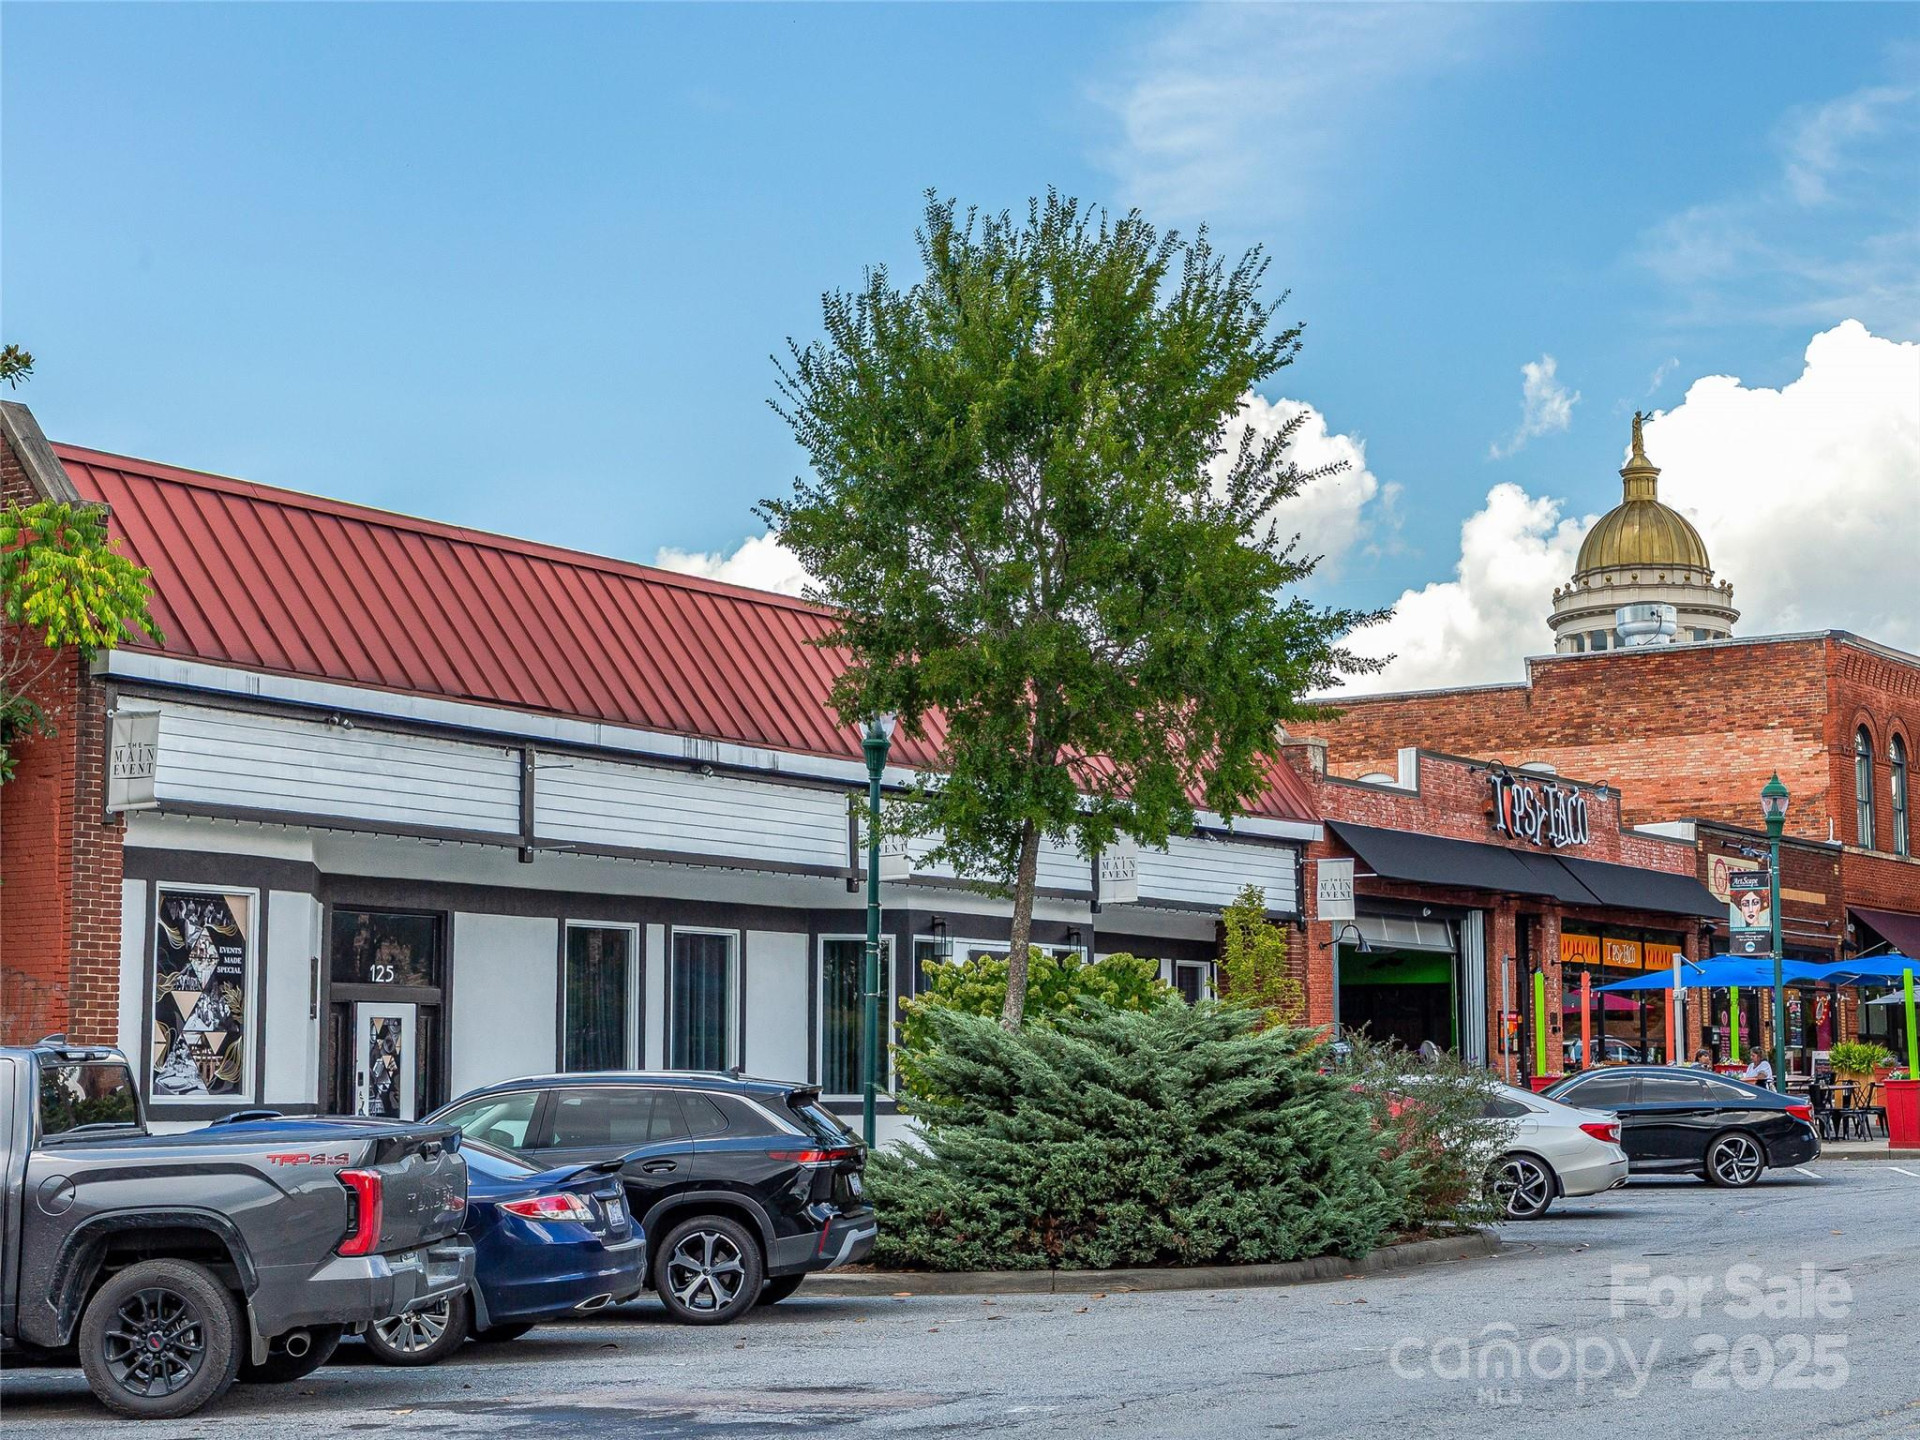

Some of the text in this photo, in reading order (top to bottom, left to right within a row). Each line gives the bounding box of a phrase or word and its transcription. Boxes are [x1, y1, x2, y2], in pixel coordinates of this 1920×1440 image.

[114, 748, 154, 762] MAIN
[113, 762, 153, 775] EVENT
[1543, 782, 1589, 848] TACO
[1102, 860, 1135, 870] MAIN
[1101, 869, 1135, 879] EVENT
[1320, 882, 1351, 891] MAIN
[219, 946, 242, 954] EVENTS
[224, 956, 242, 964] MADE
[216, 966, 242, 974] SPECIAL
[370, 964, 394, 982] 125
[266, 1153, 311, 1167] TRD
